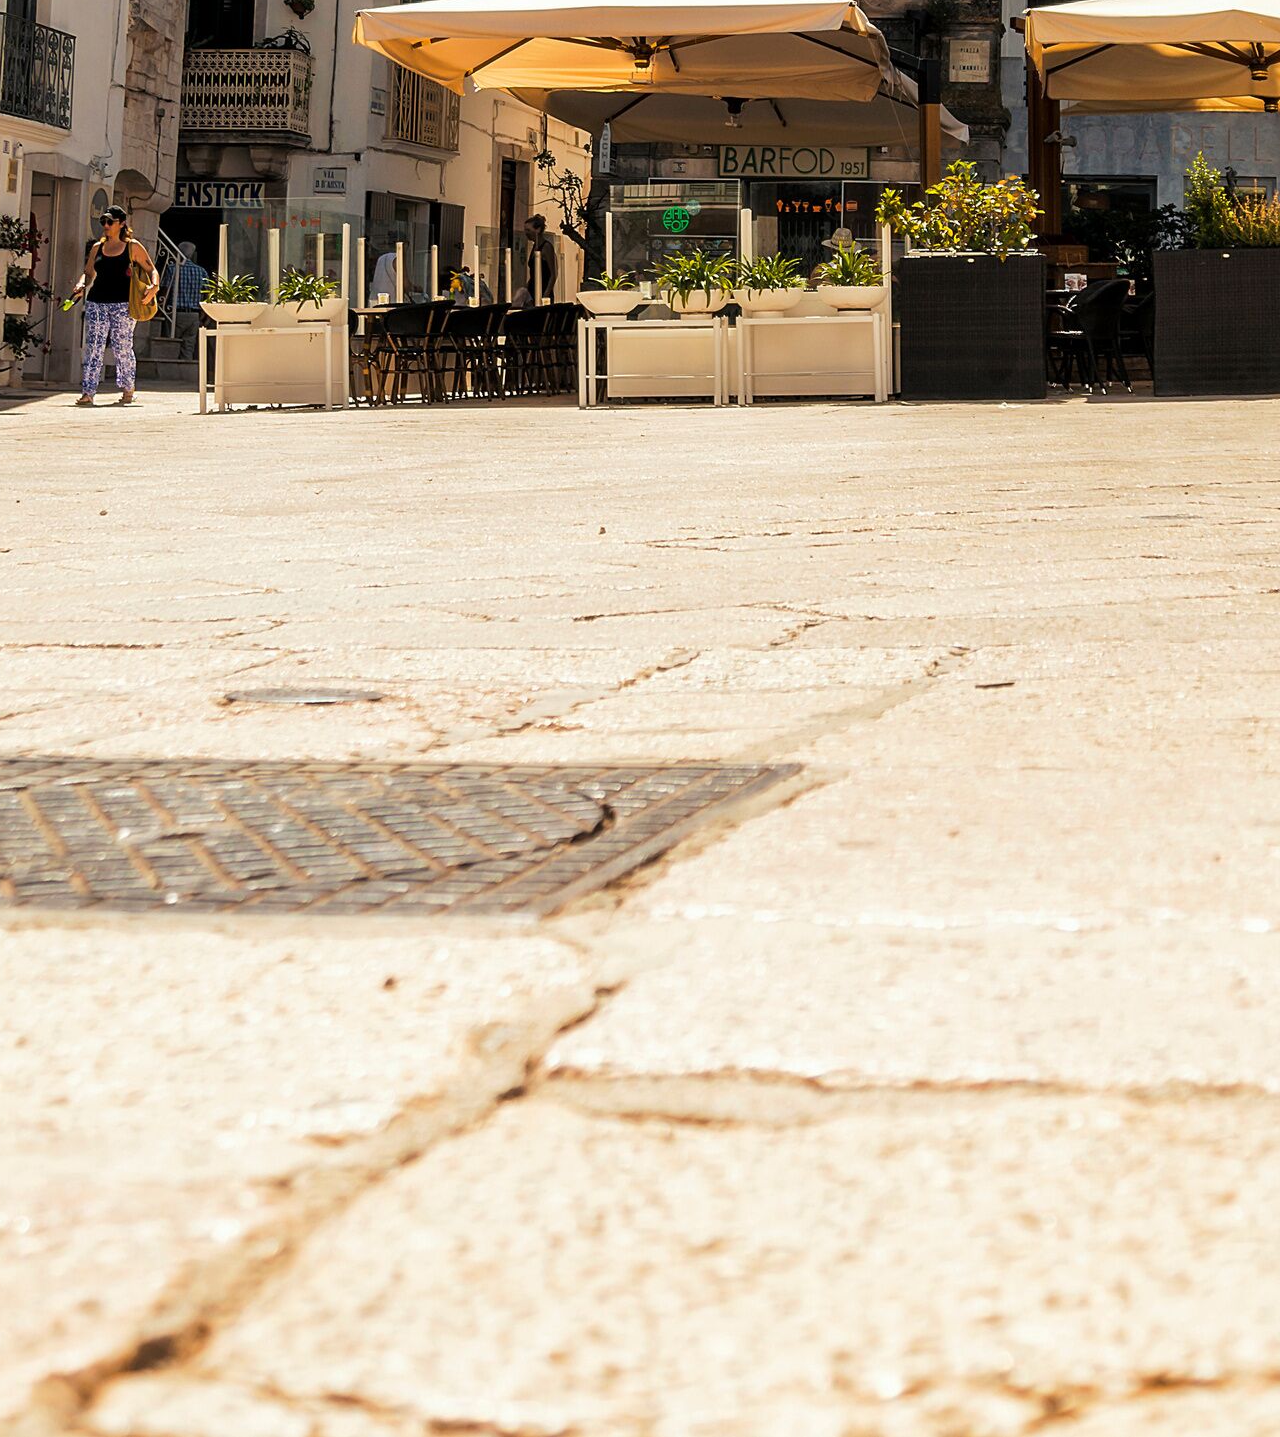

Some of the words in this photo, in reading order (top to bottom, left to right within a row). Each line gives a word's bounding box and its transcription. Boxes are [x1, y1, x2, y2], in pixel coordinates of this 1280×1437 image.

[723, 147, 835, 174] BARFOD
[840, 162, 865, 175] 1951
[323, 170, 335, 179] VIA
[175, 182, 264, 208] ENSTOCK
